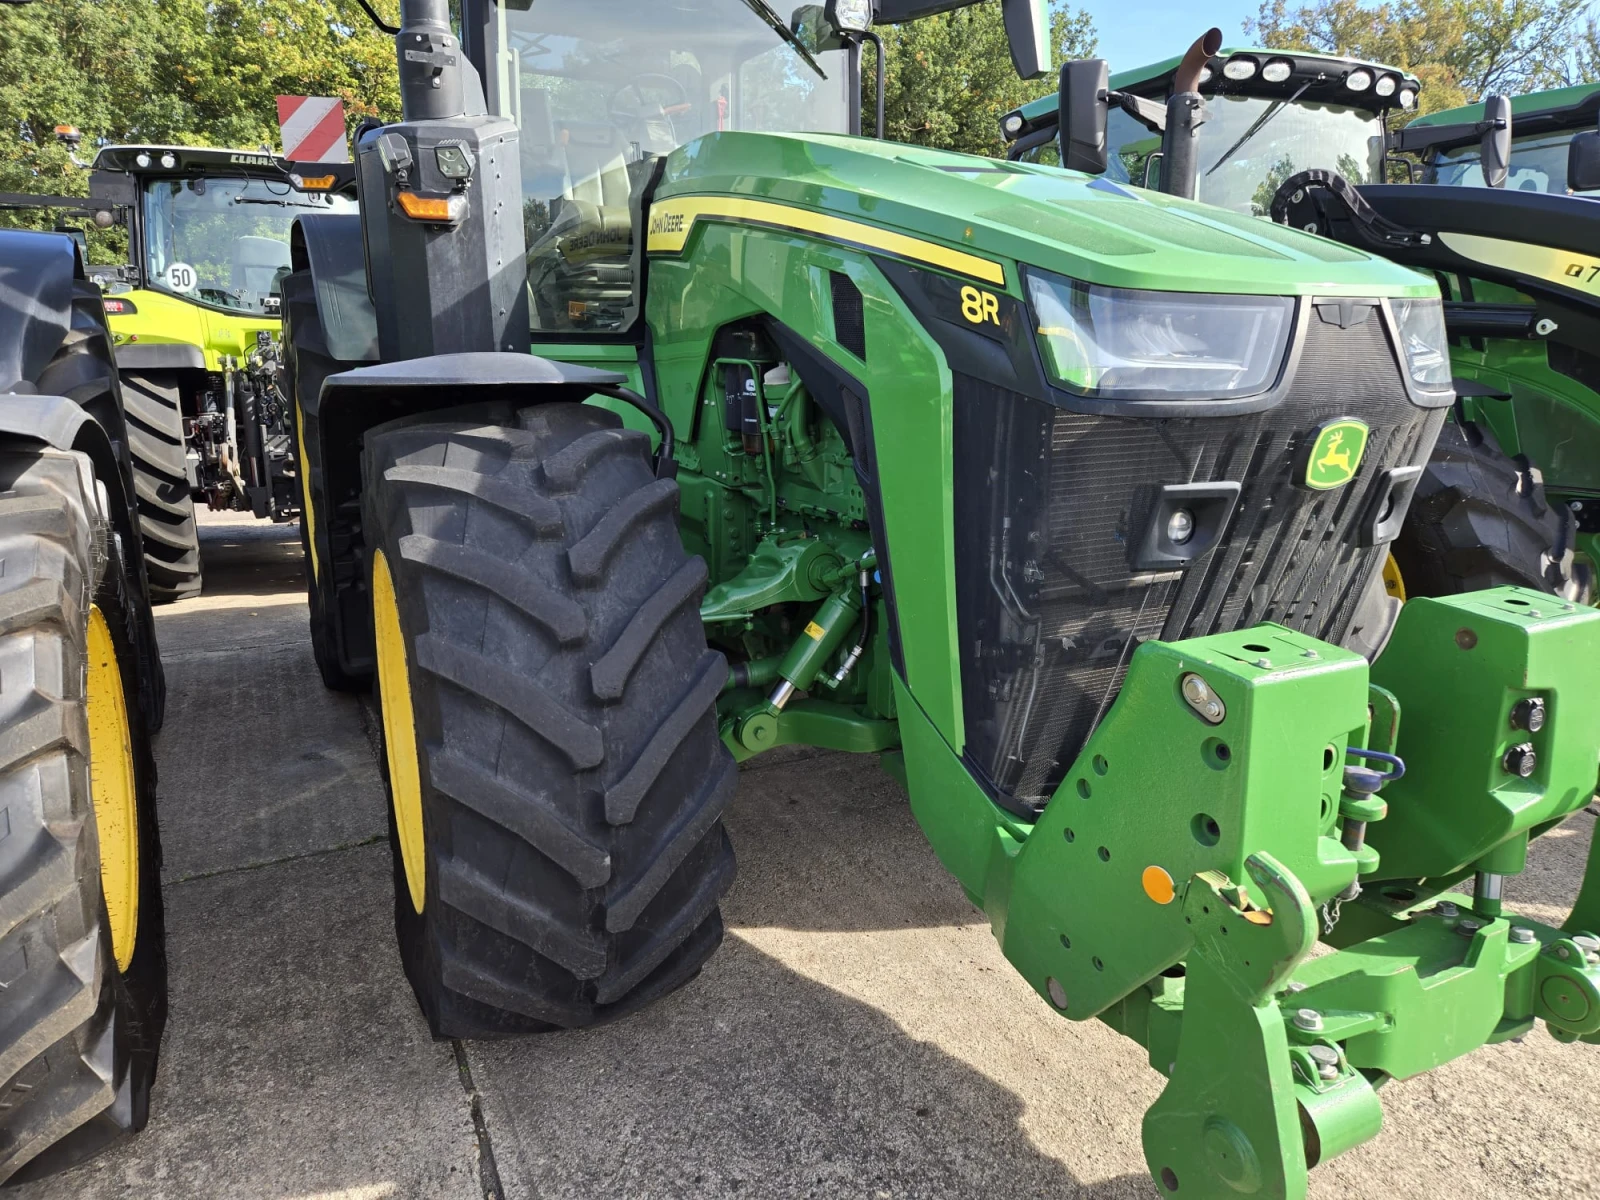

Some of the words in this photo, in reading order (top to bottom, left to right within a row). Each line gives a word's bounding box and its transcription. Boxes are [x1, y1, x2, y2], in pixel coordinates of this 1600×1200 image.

[230, 154, 278, 166] CLAAS
[650, 216, 663, 235] JOHN
[664, 213, 684, 232] DEERE
[171, 268, 191, 287] 50
[960, 285, 1001, 326] 8R
